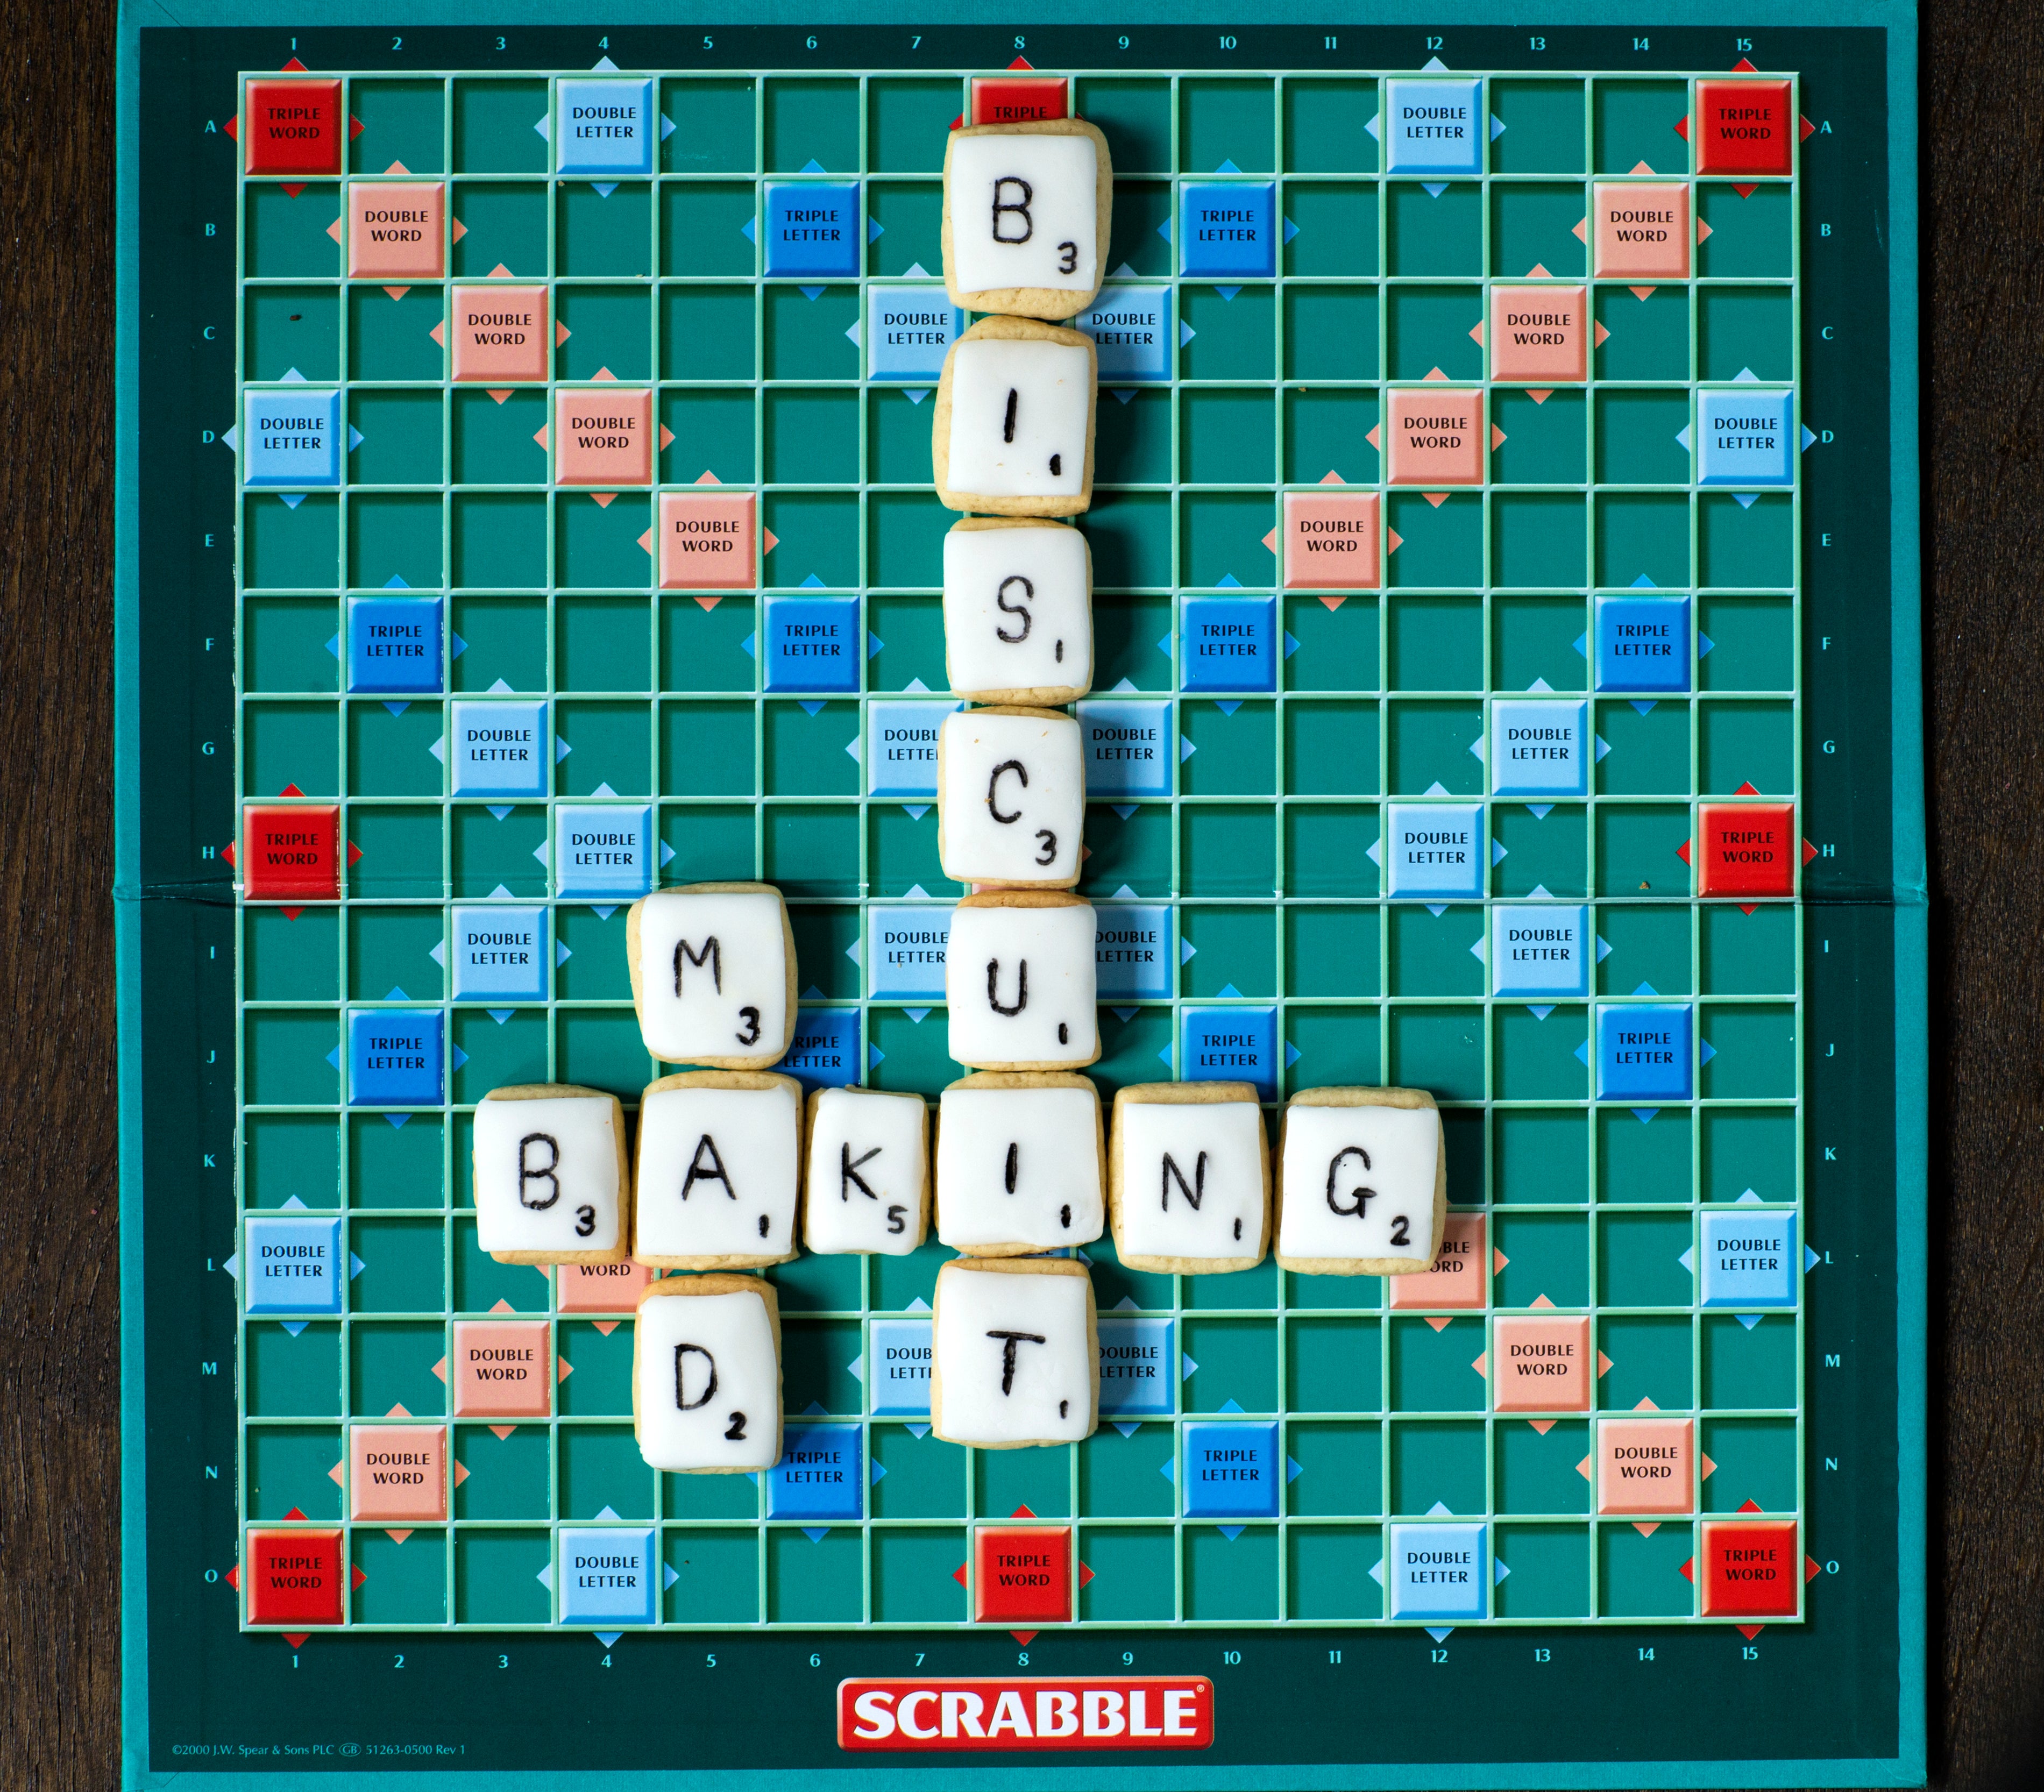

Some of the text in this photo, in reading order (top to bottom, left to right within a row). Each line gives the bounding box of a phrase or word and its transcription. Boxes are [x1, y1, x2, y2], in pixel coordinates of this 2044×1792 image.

[598, 36, 608, 49] 4
[1014, 36, 1025, 49] 8
[1427, 37, 1443, 49] 12
[268, 108, 320, 120] TRIPLE
[573, 107, 635, 119] DOUBLE
[994, 107, 1047, 118] TRIPLE
[1403, 108, 1466, 119] DOUBLE
[1719, 108, 1770, 120] TRIPLE
[205, 120, 216, 133] A
[577, 126, 633, 138] LETTER
[1407, 126, 1463, 138] LETTER
[269, 127, 320, 139] WORD
[1720, 127, 1771, 139] WORD
[786, 210, 838, 222] TRIPLE
[992, 177, 1032, 244] B
[1202, 210, 1253, 222] TRIPLE
[365, 211, 428, 223] DOUBLE
[1610, 211, 1673, 223] DOUBLE
[371, 230, 422, 241] WORD
[784, 229, 840, 241] LETTER
[1200, 230, 1256, 241] LETTER
[1616, 230, 1667, 241] WORD
[1821, 224, 1831, 236] B
[1058, 242, 1077, 275] 3
[468, 314, 531, 326] DOUBLE
[884, 314, 947, 325] DOUBLE
[1092, 314, 1155, 325] DOUBLE
[1508, 314, 1570, 326] DOUBLE
[474, 333, 525, 345] WORD
[888, 333, 945, 344] LETTER
[1096, 333, 1152, 344] LETTER
[1514, 333, 1564, 345] WORD
[1004, 388, 1018, 443] I
[261, 418, 323, 430] DOUBLE
[572, 417, 635, 429] DOUBLE
[1404, 417, 1467, 429] DOUBLE
[1714, 418, 1776, 430] DOUBLE
[265, 437, 321, 449] LETTER
[578, 436, 629, 448] WORD
[1410, 436, 1461, 448] WORD
[1718, 437, 1774, 449] LETTER
[1049, 454, 1061, 476] 1
[676, 521, 739, 533] DOUBLE
[1301, 521, 1363, 532] DOUBLE
[682, 540, 733, 552] WORD
[1307, 540, 1358, 552] WORD
[997, 576, 1034, 643] S
[371, 625, 421, 637] TRIPLE
[786, 625, 837, 637] TRIPLE
[1202, 625, 1254, 636] TRIPLE
[1617, 625, 1667, 637] TRIPLE
[367, 645, 424, 657] LETTER
[784, 644, 840, 656] LETTER
[1055, 639, 1063, 663] 1
[1200, 644, 1257, 656] LETTER
[1615, 644, 1671, 656] LETTER
[468, 730, 530, 742] DOUBLE
[1093, 729, 1155, 741] DOUBLE
[1508, 729, 1570, 740] DOUBLE
[1823, 740, 1835, 753] G
[472, 749, 528, 760] LETTER
[1097, 748, 1153, 760] LETTER
[1512, 748, 1569, 759] LETTER
[988, 760, 1028, 824] C
[266, 834, 317, 845] TRIPLE
[572, 834, 635, 845] DOUBLE
[1405, 833, 1467, 844] DOUBLE
[1721, 831, 1773, 843] TRIPLE
[202, 846, 214, 859] H
[1035, 829, 1057, 866] 3
[267, 852, 318, 865] WORD
[576, 853, 633, 865] LETTER
[1409, 852, 1465, 863] LETTER
[1722, 851, 1773, 863] WORD
[469, 933, 531, 945] DOUBLE
[885, 932, 948, 944] DOUBLE
[1509, 929, 1572, 941] DOUBLE
[472, 952, 529, 964] LETTER
[889, 951, 945, 963] LETTER
[1097, 951, 1153, 963] LETTER
[1513, 949, 1570, 960] LETTER
[673, 936, 721, 998] M
[987, 958, 1028, 1016] U
[736, 1006, 761, 1046] 3
[1058, 1022, 1068, 1045] 1
[1619, 1033, 1670, 1044] TRIPLE
[371, 1038, 422, 1049] TRIPLE
[1203, 1035, 1254, 1047] TRIPLE
[368, 1057, 424, 1069] LETTER
[785, 1056, 841, 1067] LETTER
[1201, 1054, 1257, 1066] LETTER
[1616, 1051, 1673, 1064] LETTER
[1825, 1147, 1836, 1160] K
[520, 1133, 560, 1211] B
[682, 1134, 736, 1200] A
[841, 1142, 882, 1201] K
[1005, 1142, 1018, 1194] I
[1162, 1151, 1208, 1212] N
[1326, 1146, 1377, 1219] G
[575, 1205, 595, 1237] 3
[888, 1205, 907, 1234] 5
[1060, 1204, 1071, 1228] 1
[758, 1214, 770, 1238] 1
[1233, 1218, 1242, 1241] 1
[1390, 1215, 1410, 1246] 2
[1717, 1239, 1780, 1251] DOUBLE
[262, 1246, 324, 1257] DOUBLE
[580, 1264, 630, 1276] WORD
[1721, 1258, 1777, 1270] LETTER
[266, 1265, 322, 1276] LETTER
[470, 1349, 533, 1361] DOUBLE
[1511, 1345, 1573, 1356] DOUBLE
[202, 1362, 217, 1375] M
[986, 1331, 1046, 1396] T
[1517, 1364, 1567, 1375] WORD
[476, 1368, 527, 1380] WORD
[674, 1343, 718, 1410] D
[1059, 1400, 1068, 1419] 1
[725, 1411, 747, 1440] 2
[367, 1453, 429, 1465] DOUBLE
[788, 1452, 841, 1463] TRIPLE
[1205, 1450, 1256, 1462] TRIPLE
[1615, 1447, 1677, 1459] DOUBLE
[786, 1471, 843, 1482] LETTER
[1202, 1469, 1259, 1481] LETTER
[1621, 1466, 1671, 1478] WORD
[373, 1473, 424, 1484] WORD
[998, 1555, 1049, 1567] TRIPLE
[1408, 1552, 1469, 1563] DOUBLE
[1724, 1549, 1776, 1561] TRIPLE
[269, 1558, 321, 1569] TRIPLE
[576, 1556, 638, 1568] DOUBLE
[999, 1574, 1050, 1586] WORD
[1411, 1571, 1467, 1583] LETTER
[1726, 1568, 1776, 1581] WORD
[271, 1576, 322, 1589] WORD
[579, 1575, 636, 1587] LETTER
[810, 1653, 821, 1667] 6
[1638, 1648, 1655, 1661] 14
[172, 1745, 465, 1758] ©2000 J.W. Spear & Sons PLC GB 51263-0500 Rev 1
